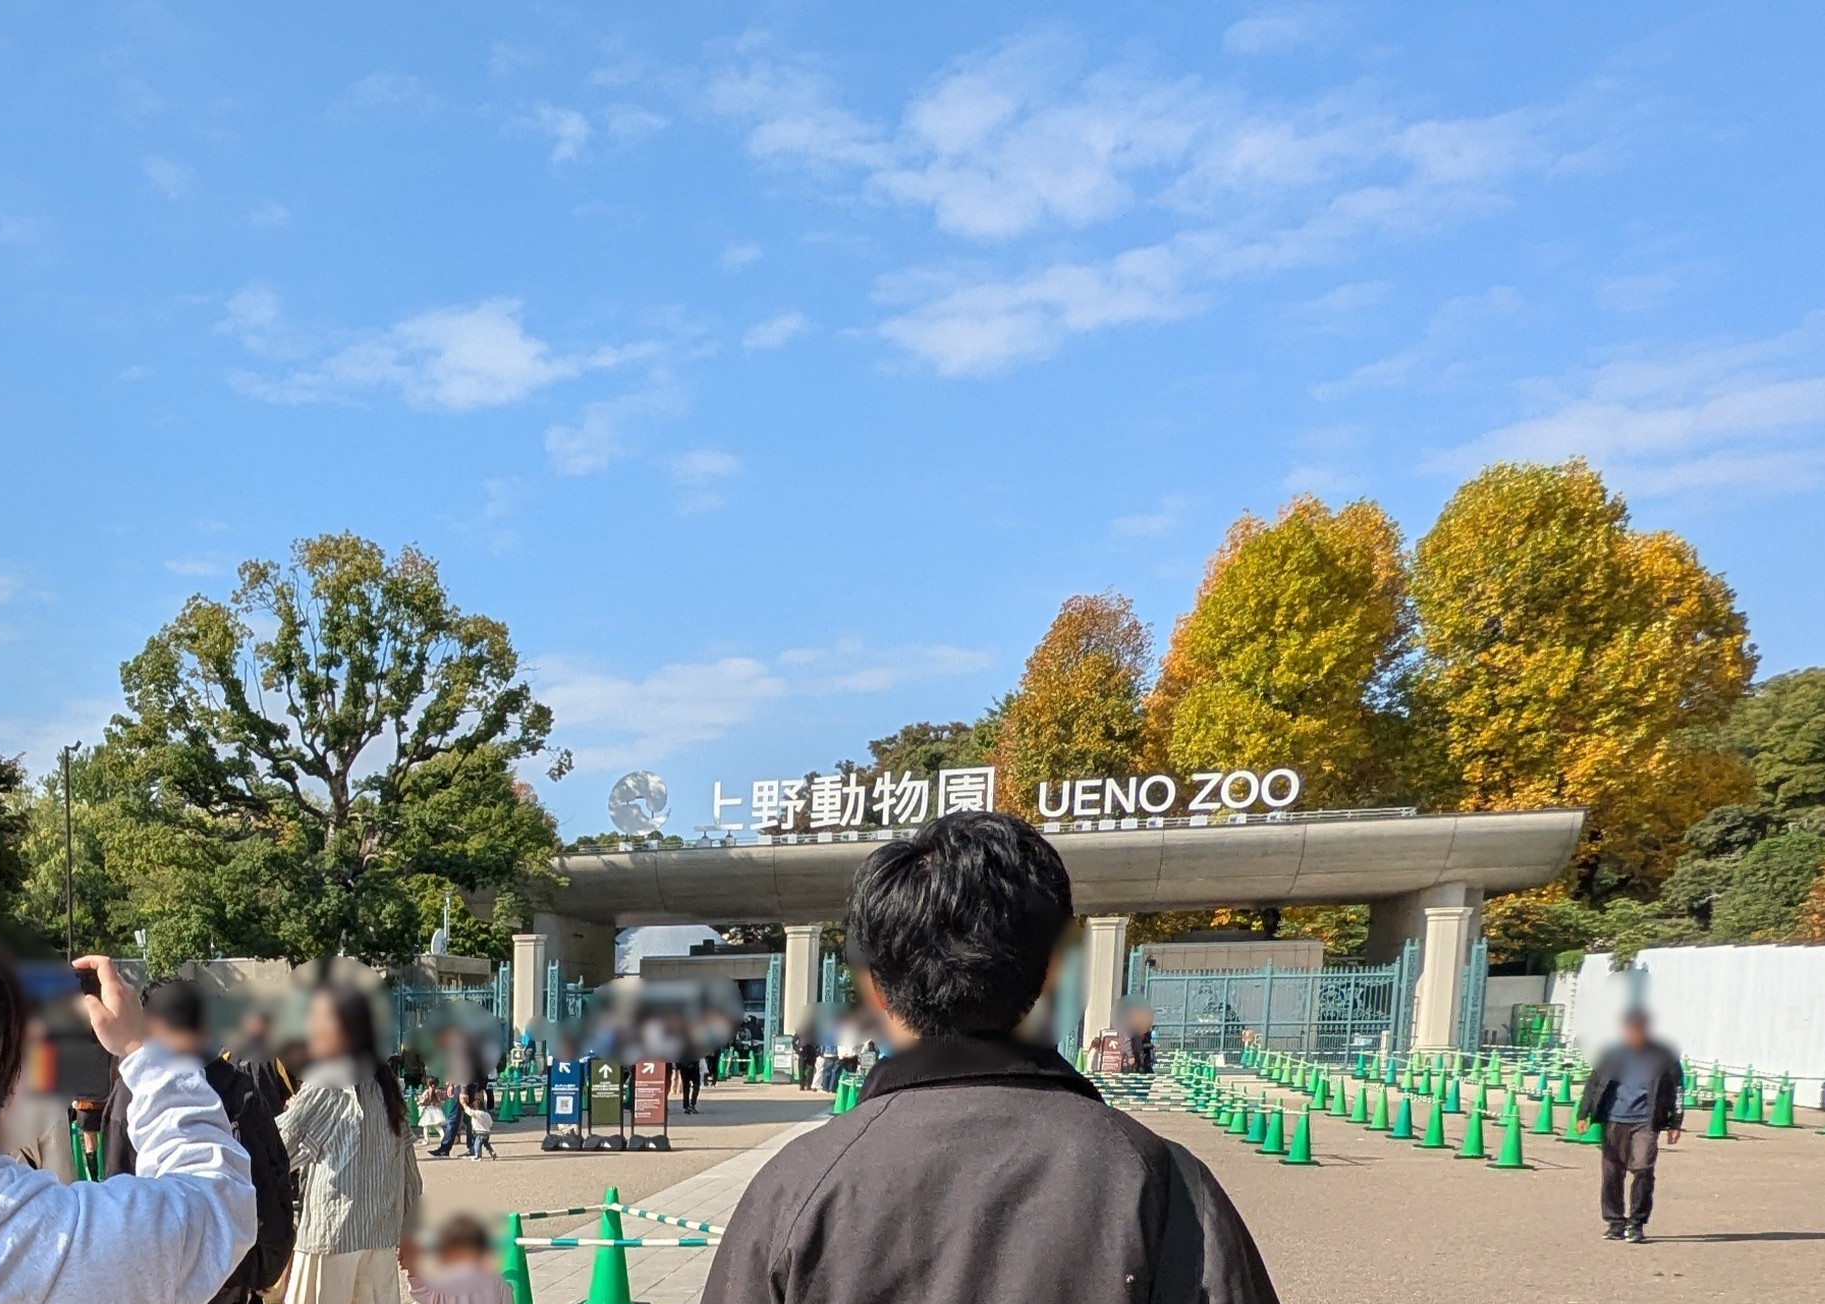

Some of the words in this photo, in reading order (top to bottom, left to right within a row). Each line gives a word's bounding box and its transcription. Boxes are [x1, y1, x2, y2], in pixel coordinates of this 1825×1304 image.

[711, 766, 996, 831] 上野動物園
[1038, 774, 1177, 818] UENO
[1188, 768, 1301, 811] ZOO
